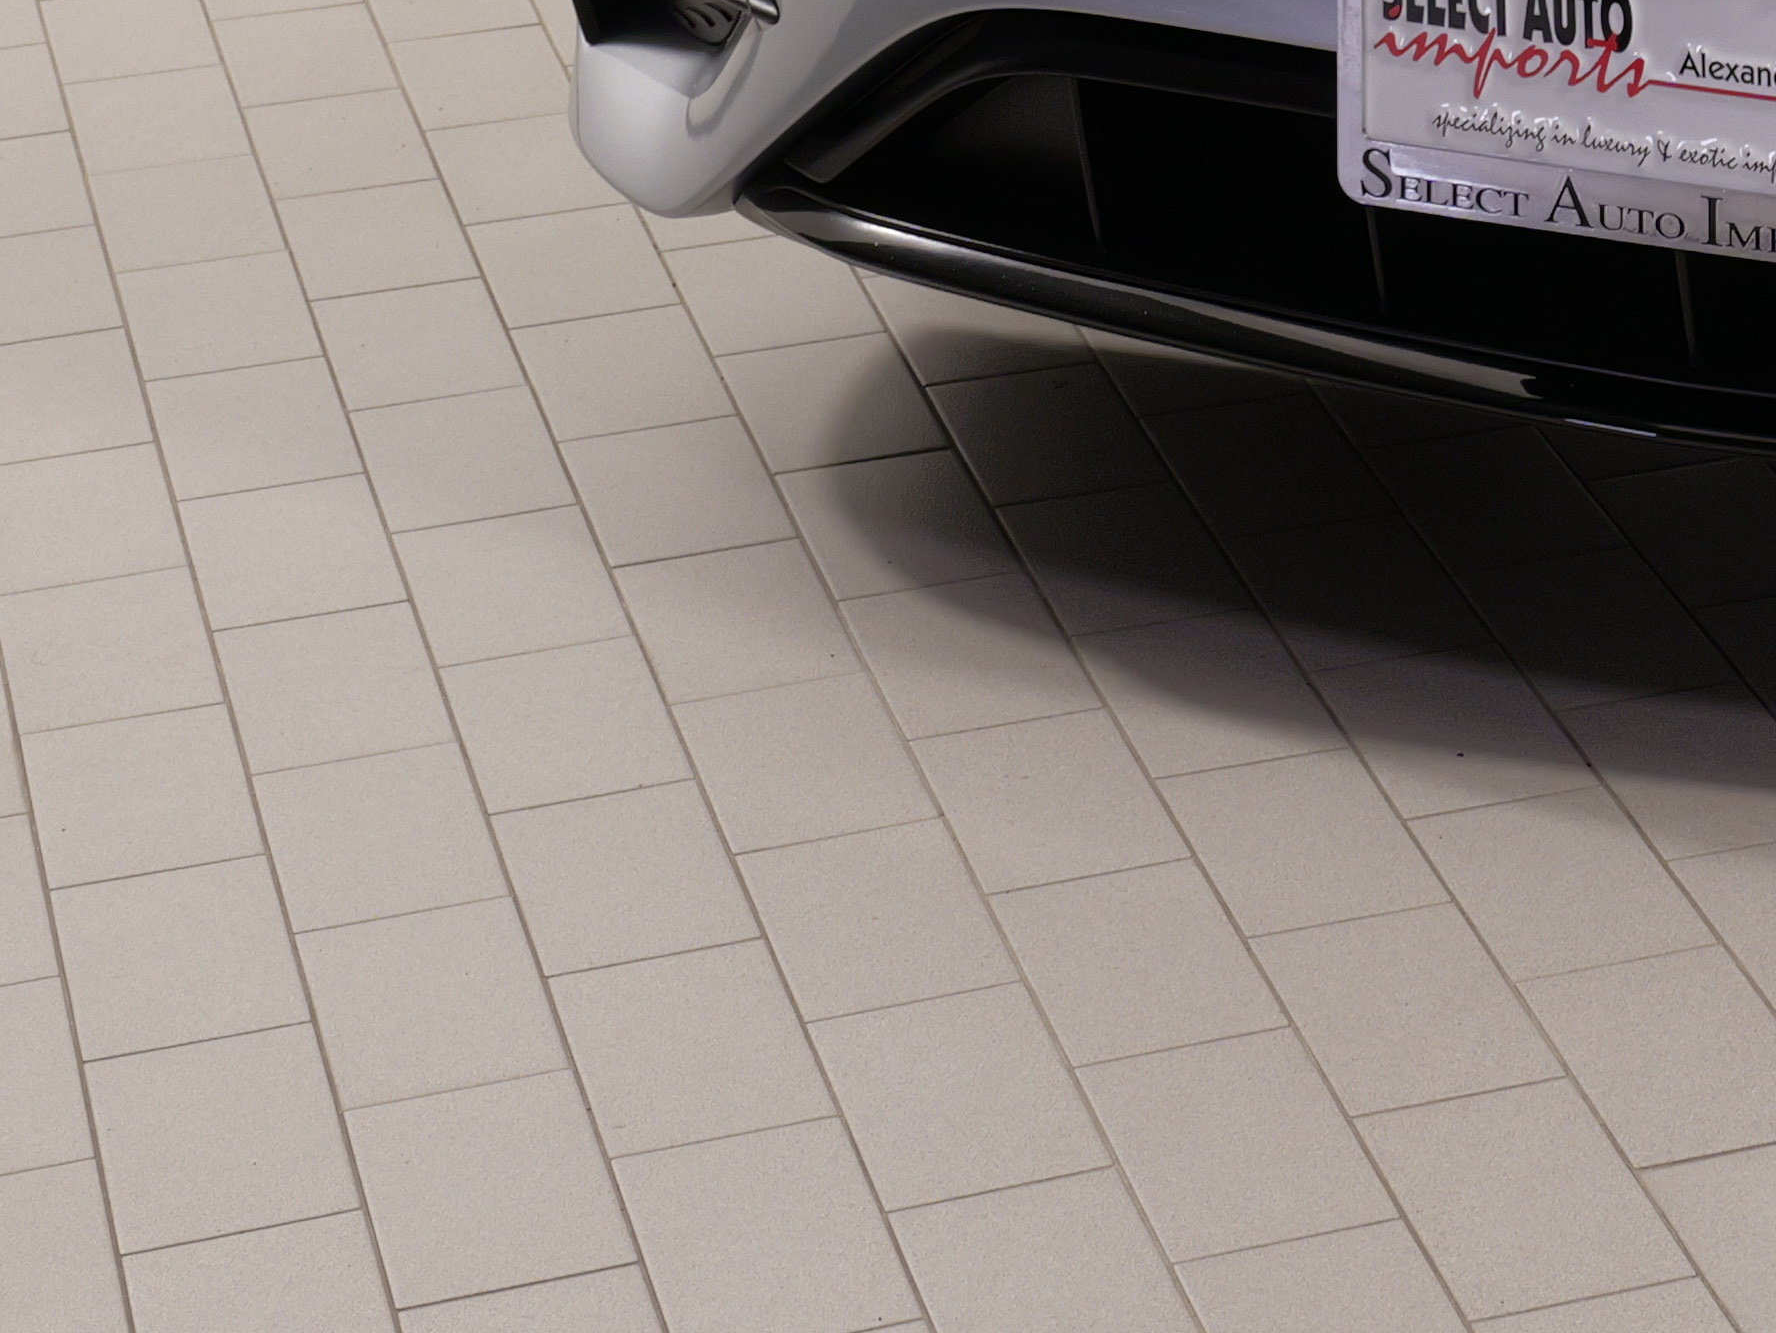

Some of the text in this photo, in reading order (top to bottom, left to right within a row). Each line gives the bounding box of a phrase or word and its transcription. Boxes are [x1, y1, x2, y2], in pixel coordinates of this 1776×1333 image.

[1374, 28, 1651, 99] imports
[1432, 110, 1547, 153] specializing
[1550, 124, 1577, 146] in
[1580, 124, 1652, 167] luxury
[1678, 146, 1739, 171] exotic
